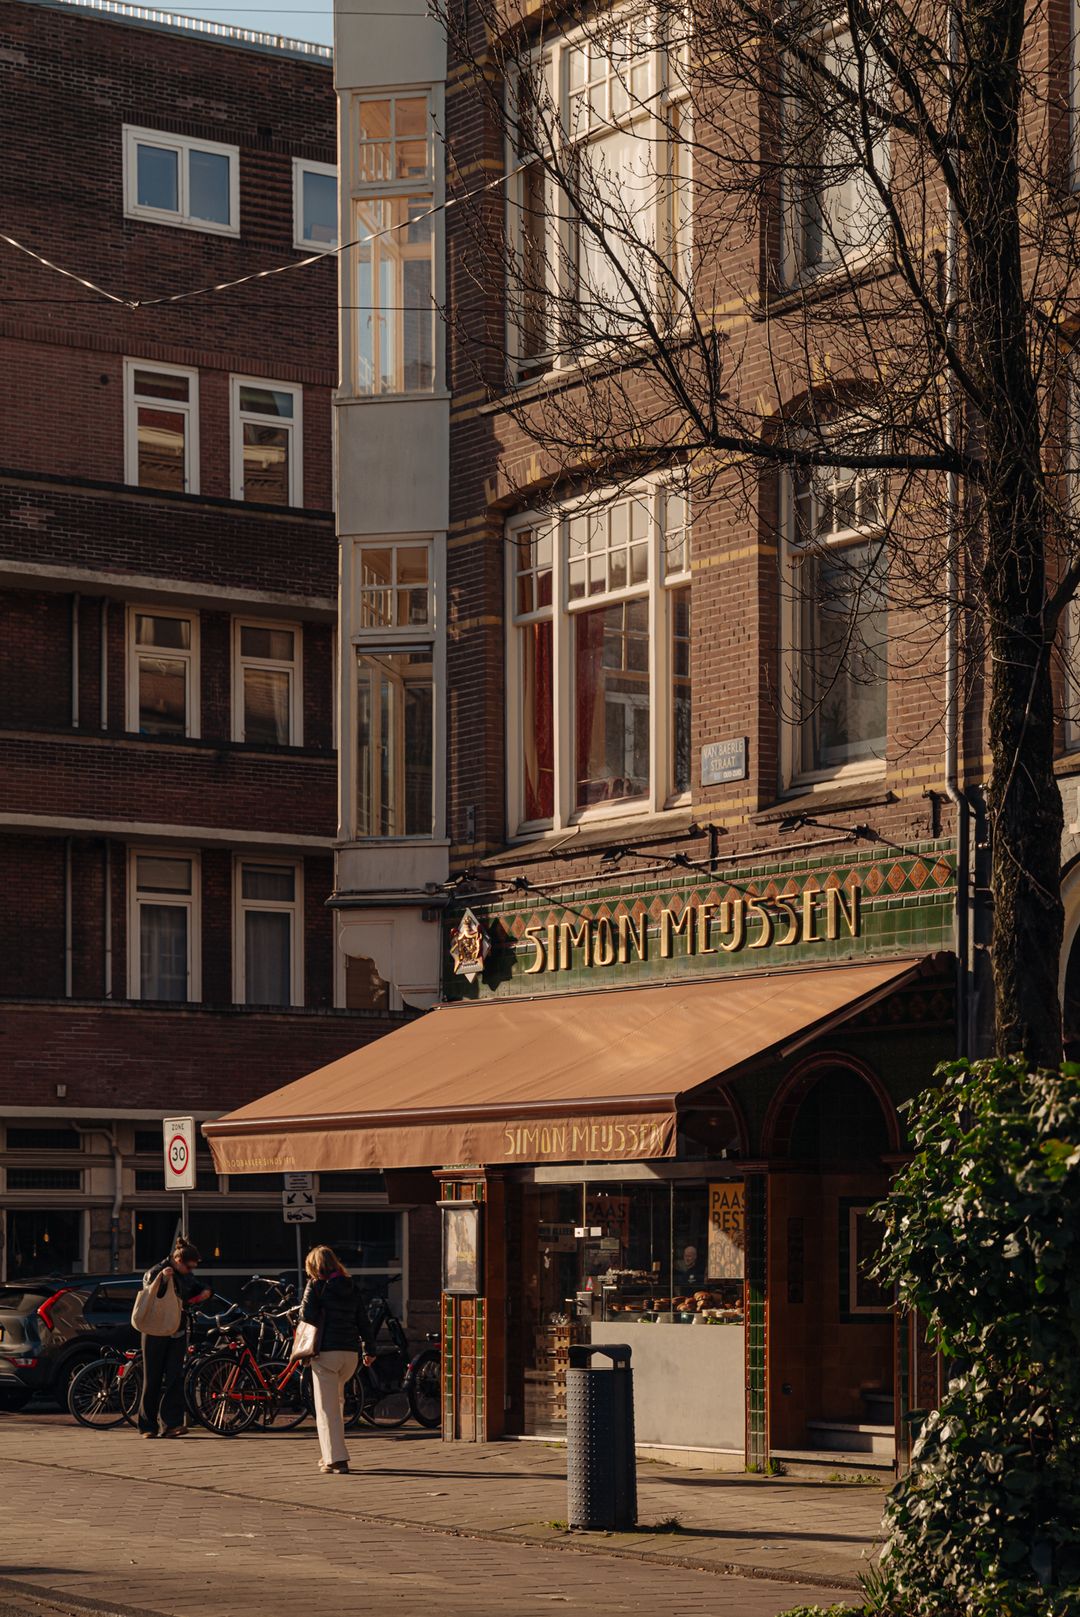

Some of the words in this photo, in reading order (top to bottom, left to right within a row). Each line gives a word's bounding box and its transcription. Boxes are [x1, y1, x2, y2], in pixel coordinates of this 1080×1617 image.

[703, 745, 719, 758] VAN
[711, 756, 735, 771] STRAAT
[524, 912, 645, 974] SIMON
[171, 1122, 185, 1131] ZONE
[504, 1126, 565, 1155] SIMON
[172, 1146, 186, 1162] 30
